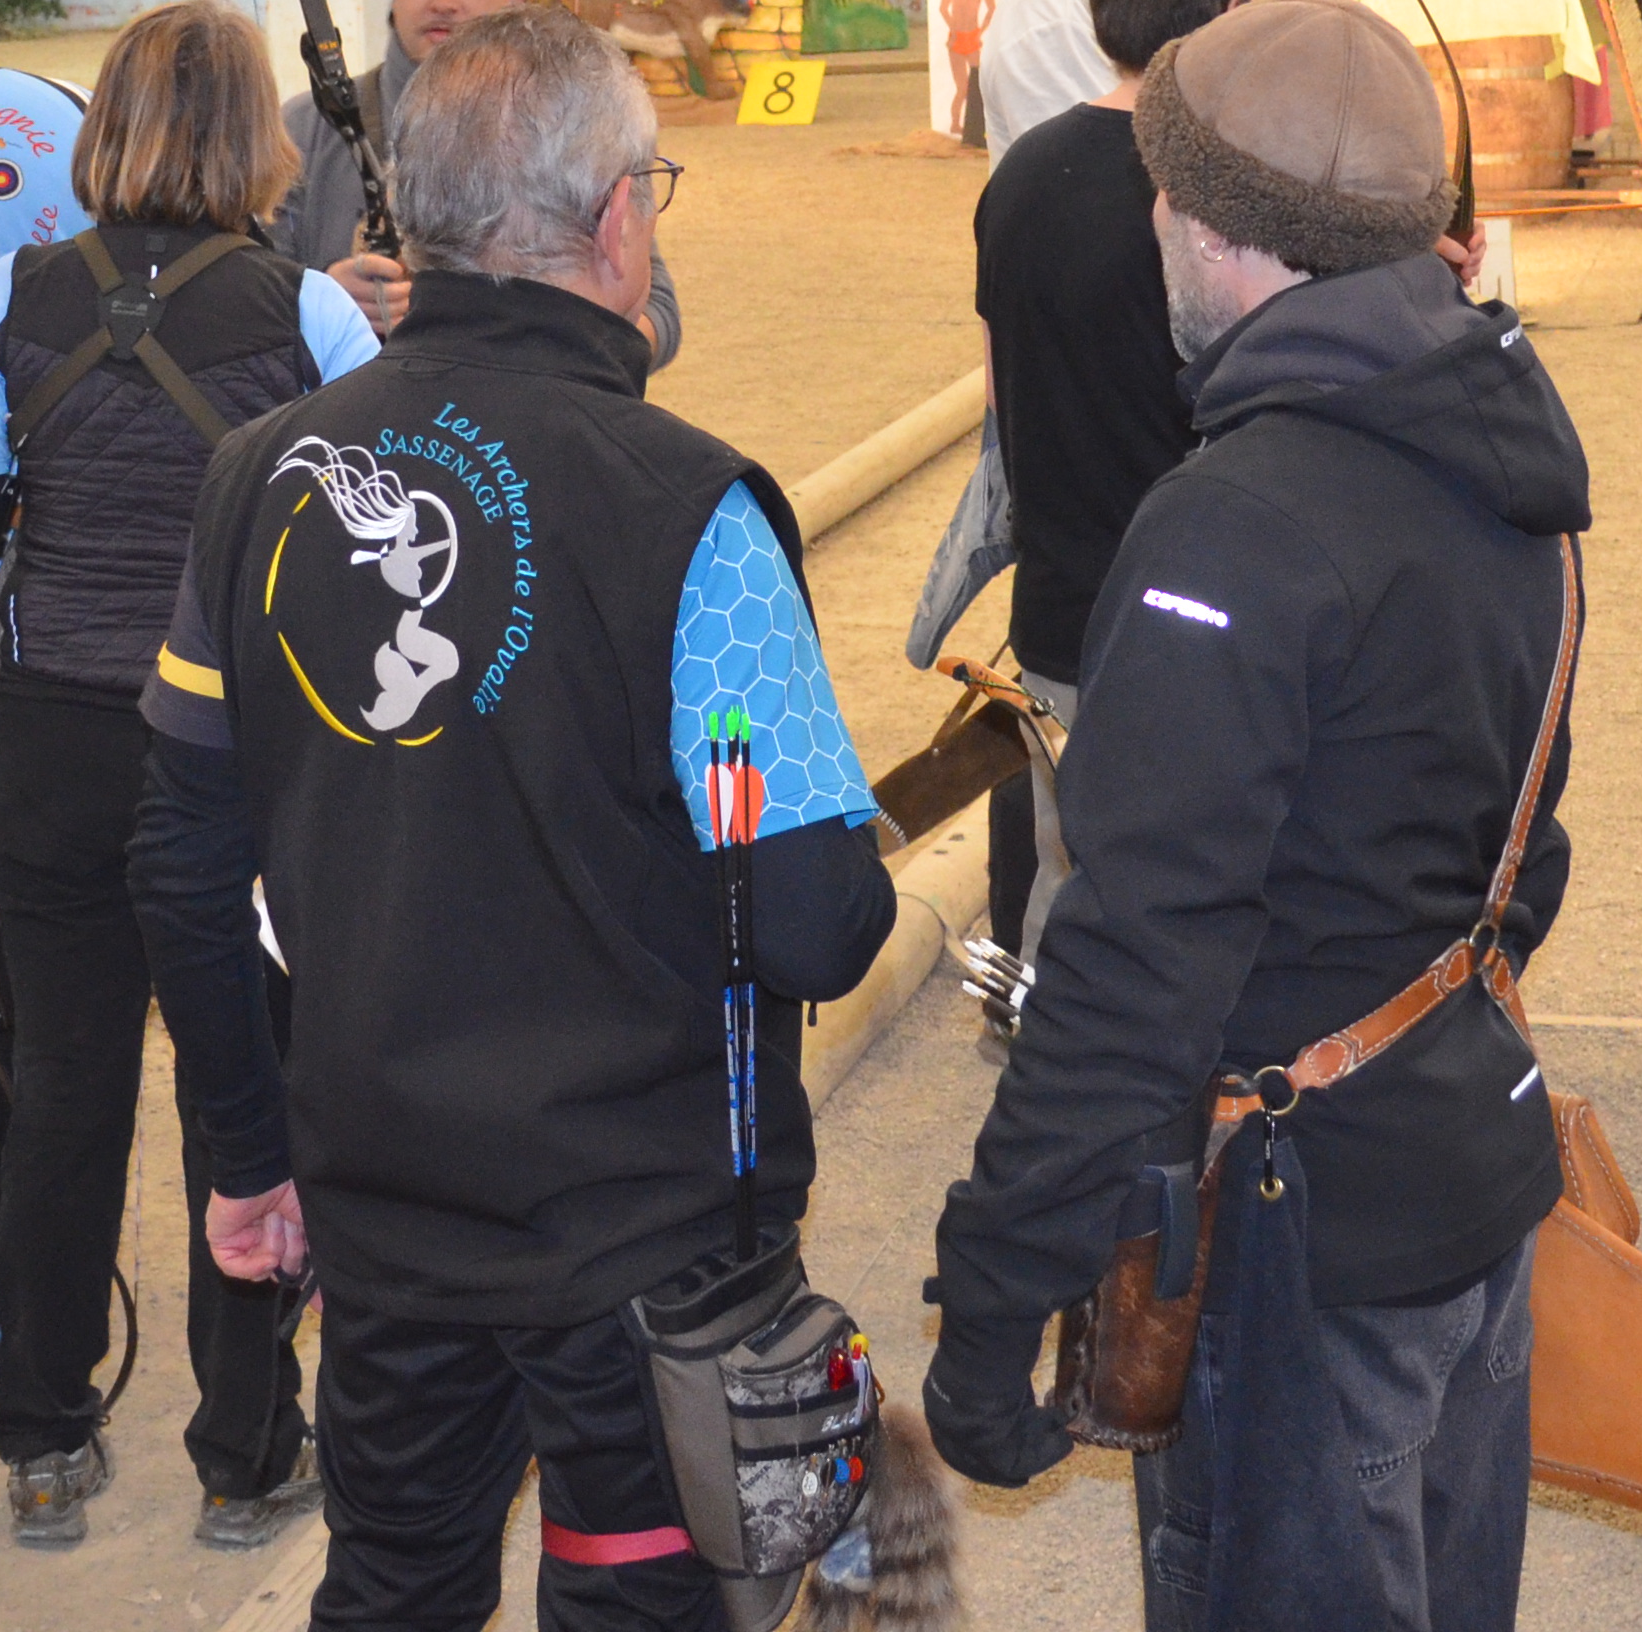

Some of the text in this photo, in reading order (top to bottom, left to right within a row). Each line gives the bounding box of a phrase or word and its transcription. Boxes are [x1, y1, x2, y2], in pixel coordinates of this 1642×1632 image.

[763, 71, 795, 115] 8
[432, 401, 482, 443] Les
[475, 440, 533, 550] Archers
[514, 557, 537, 597] de
